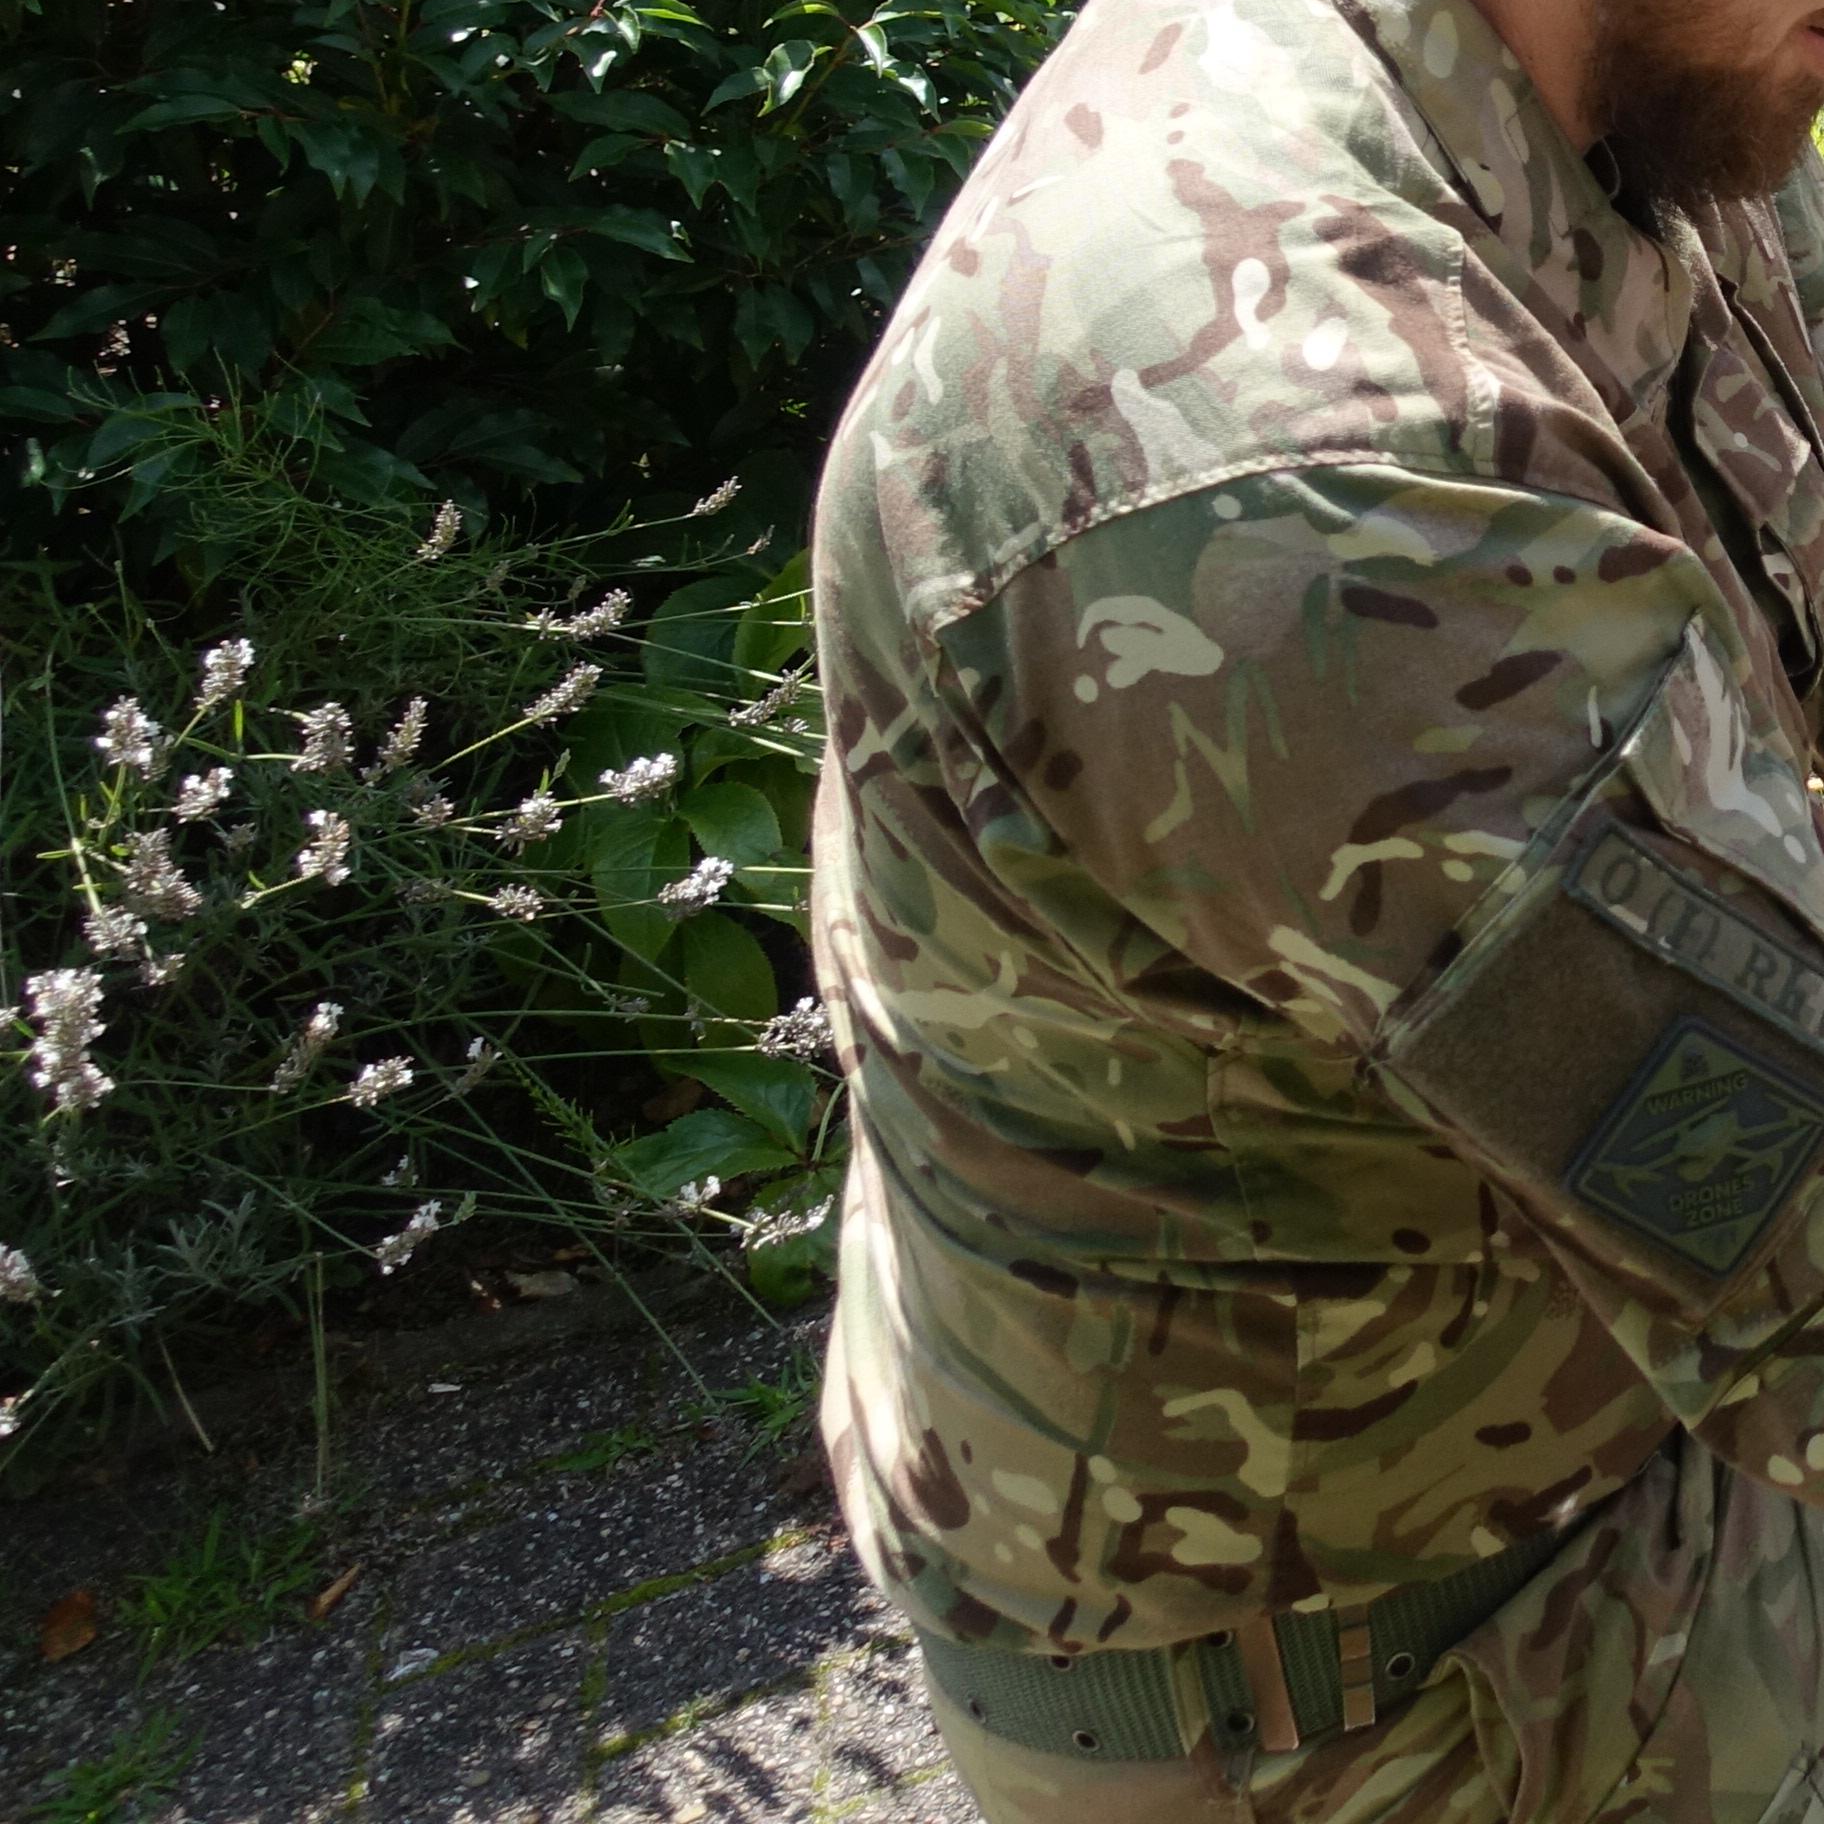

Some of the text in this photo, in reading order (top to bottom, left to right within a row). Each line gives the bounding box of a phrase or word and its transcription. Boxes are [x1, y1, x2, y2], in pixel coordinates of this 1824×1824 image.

[1601, 854, 1641, 905] O
[1649, 1072, 1747, 1115] WARNING
[1669, 1176, 1755, 1212] DRONES
[1686, 1198, 1744, 1225] ZONE
